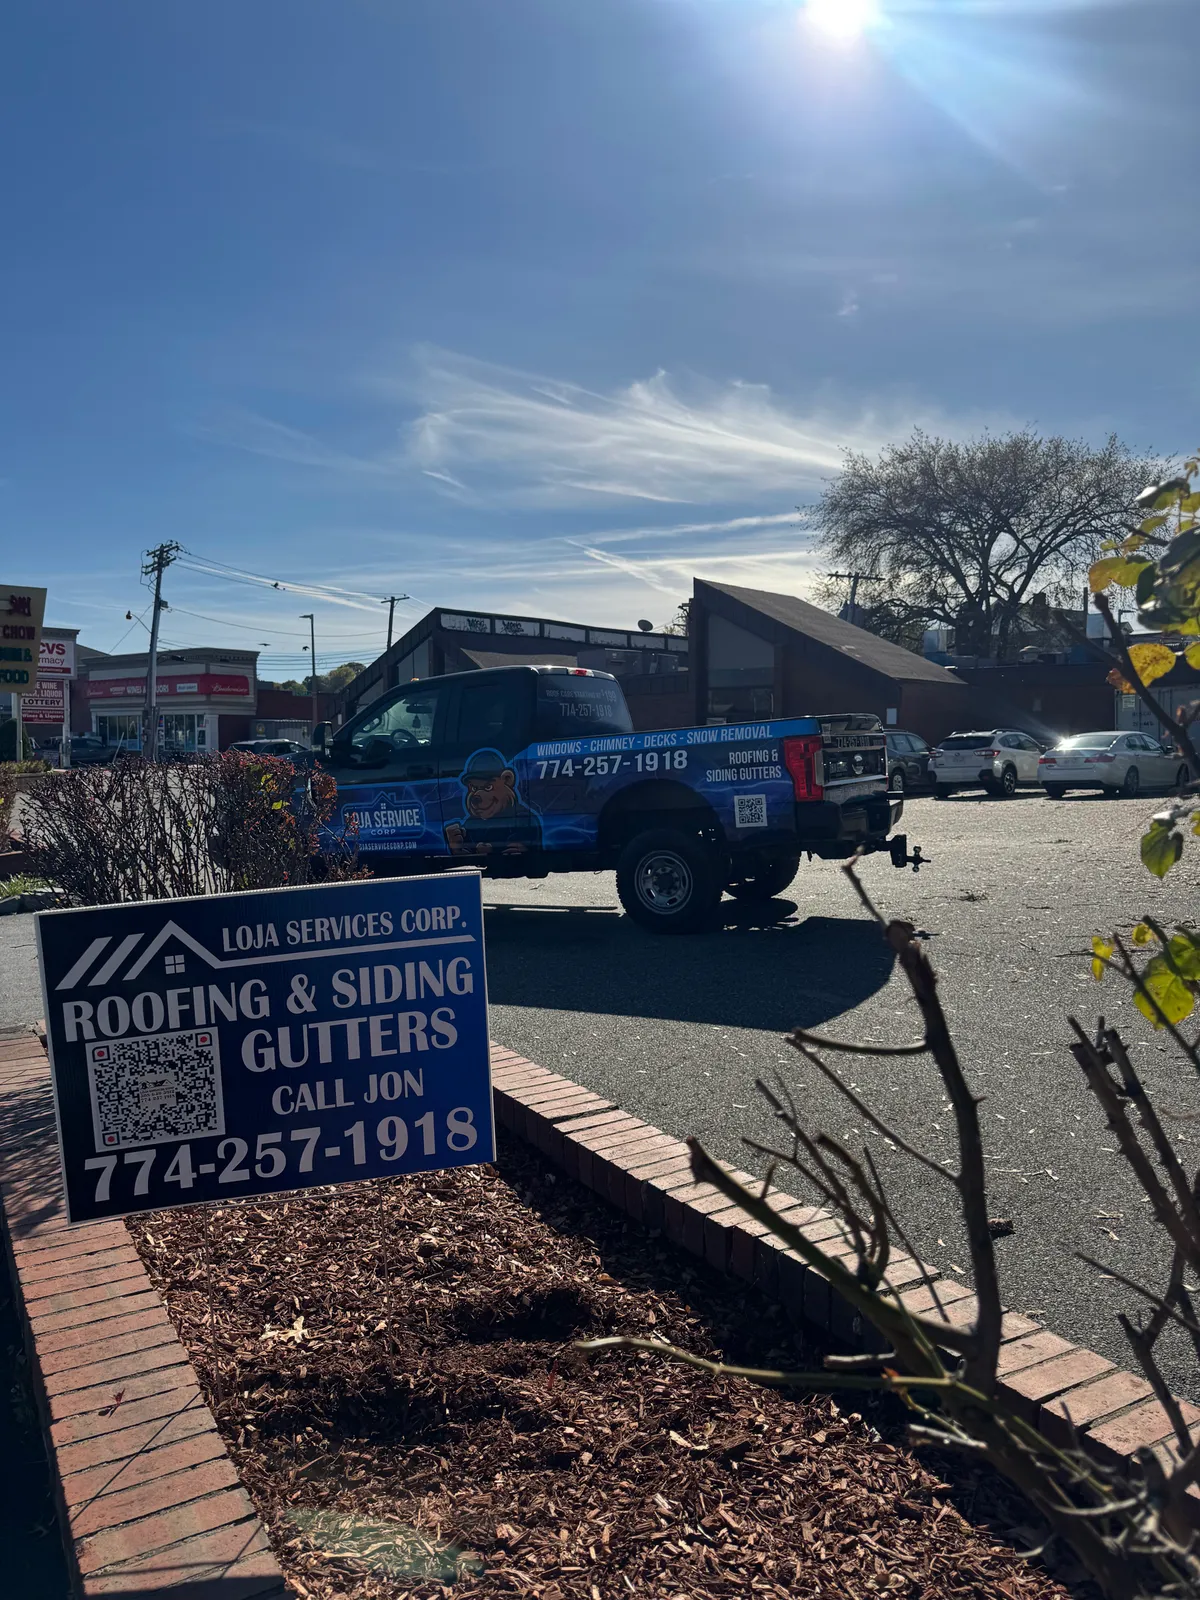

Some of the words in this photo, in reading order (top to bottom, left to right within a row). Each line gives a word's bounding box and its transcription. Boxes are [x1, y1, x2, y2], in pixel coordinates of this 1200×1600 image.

[3, 625, 35, 640] CHOW
[39, 642, 66, 655] CVS
[39, 658, 65, 666] rmacy
[41, 681, 58, 690] WINE
[41, 690, 63, 698] LIQUOR
[23, 698, 61, 706] LOTTERY
[560, 703, 613, 718] 774-257-1918
[537, 741, 582, 757] WINDOWS
[590, 737, 634, 753] CHIMNEY
[645, 733, 677, 748] DECKS
[687, 729, 719, 745] SNOW
[720, 725, 772, 741] REMOVAL
[536, 749, 688, 780] 774-257-1918
[729, 750, 769, 765] ROOFING
[771, 749, 778, 762] &
[706, 767, 738, 783] SIDING
[740, 765, 782, 781] GUTTERS
[345, 811, 373, 829] OJA
[374, 809, 421, 828] SERVICE
[359, 842, 417, 851] OJASERVICECORP.COM
[222, 920, 279, 952] LOJA
[286, 911, 393, 944] SERVICES
[401, 905, 467, 934] CORP.
[62, 979, 270, 1043] ROOFING
[286, 973, 317, 1015] &
[332, 956, 474, 1008] SIDING
[241, 1007, 458, 1073] GUTTERS
[271, 1079, 354, 1116] CALL
[363, 1068, 424, 1104] JON
[84, 1106, 478, 1203] 774-257-1918
